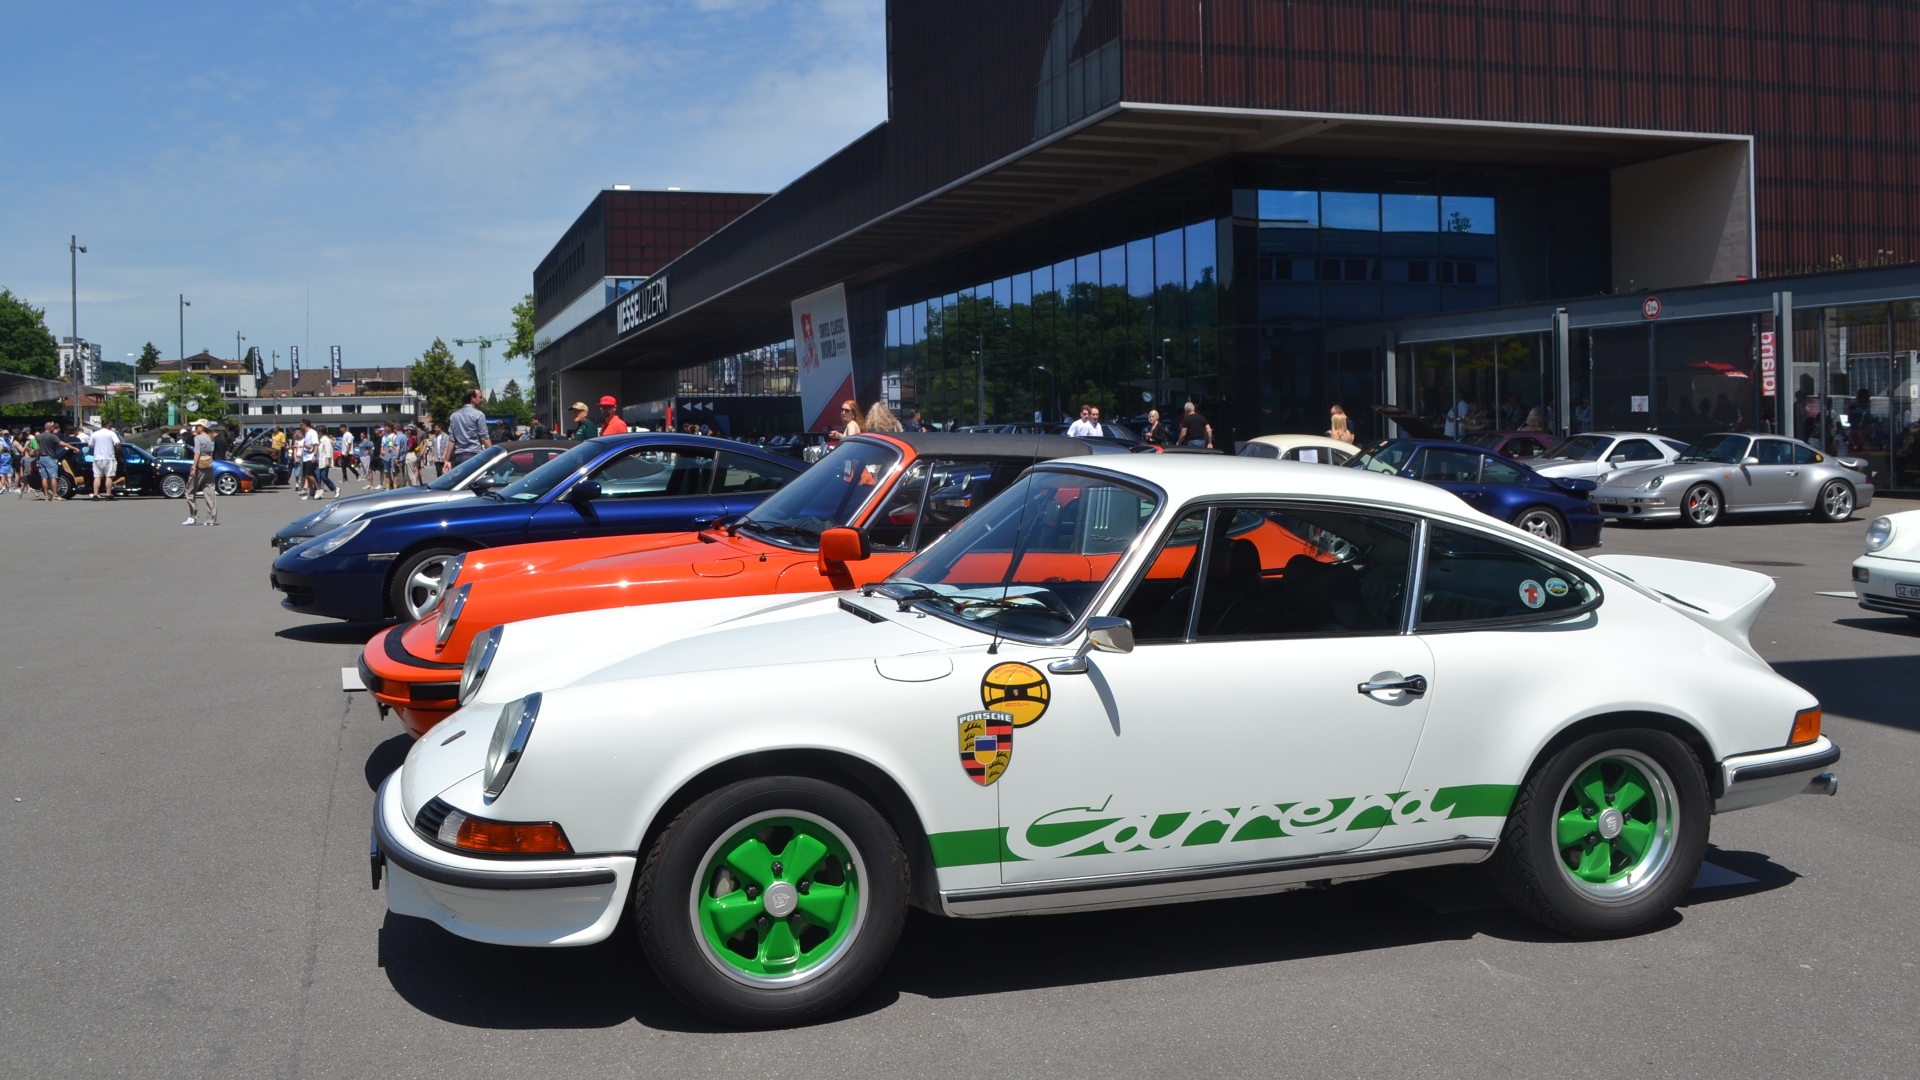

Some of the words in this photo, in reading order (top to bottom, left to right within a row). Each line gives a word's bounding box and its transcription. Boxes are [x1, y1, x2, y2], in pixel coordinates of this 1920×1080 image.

[821, 339, 837, 359] WORLD
[959, 712, 1012, 725] PORSCHE
[1006, 794, 1457, 861] Carrera
